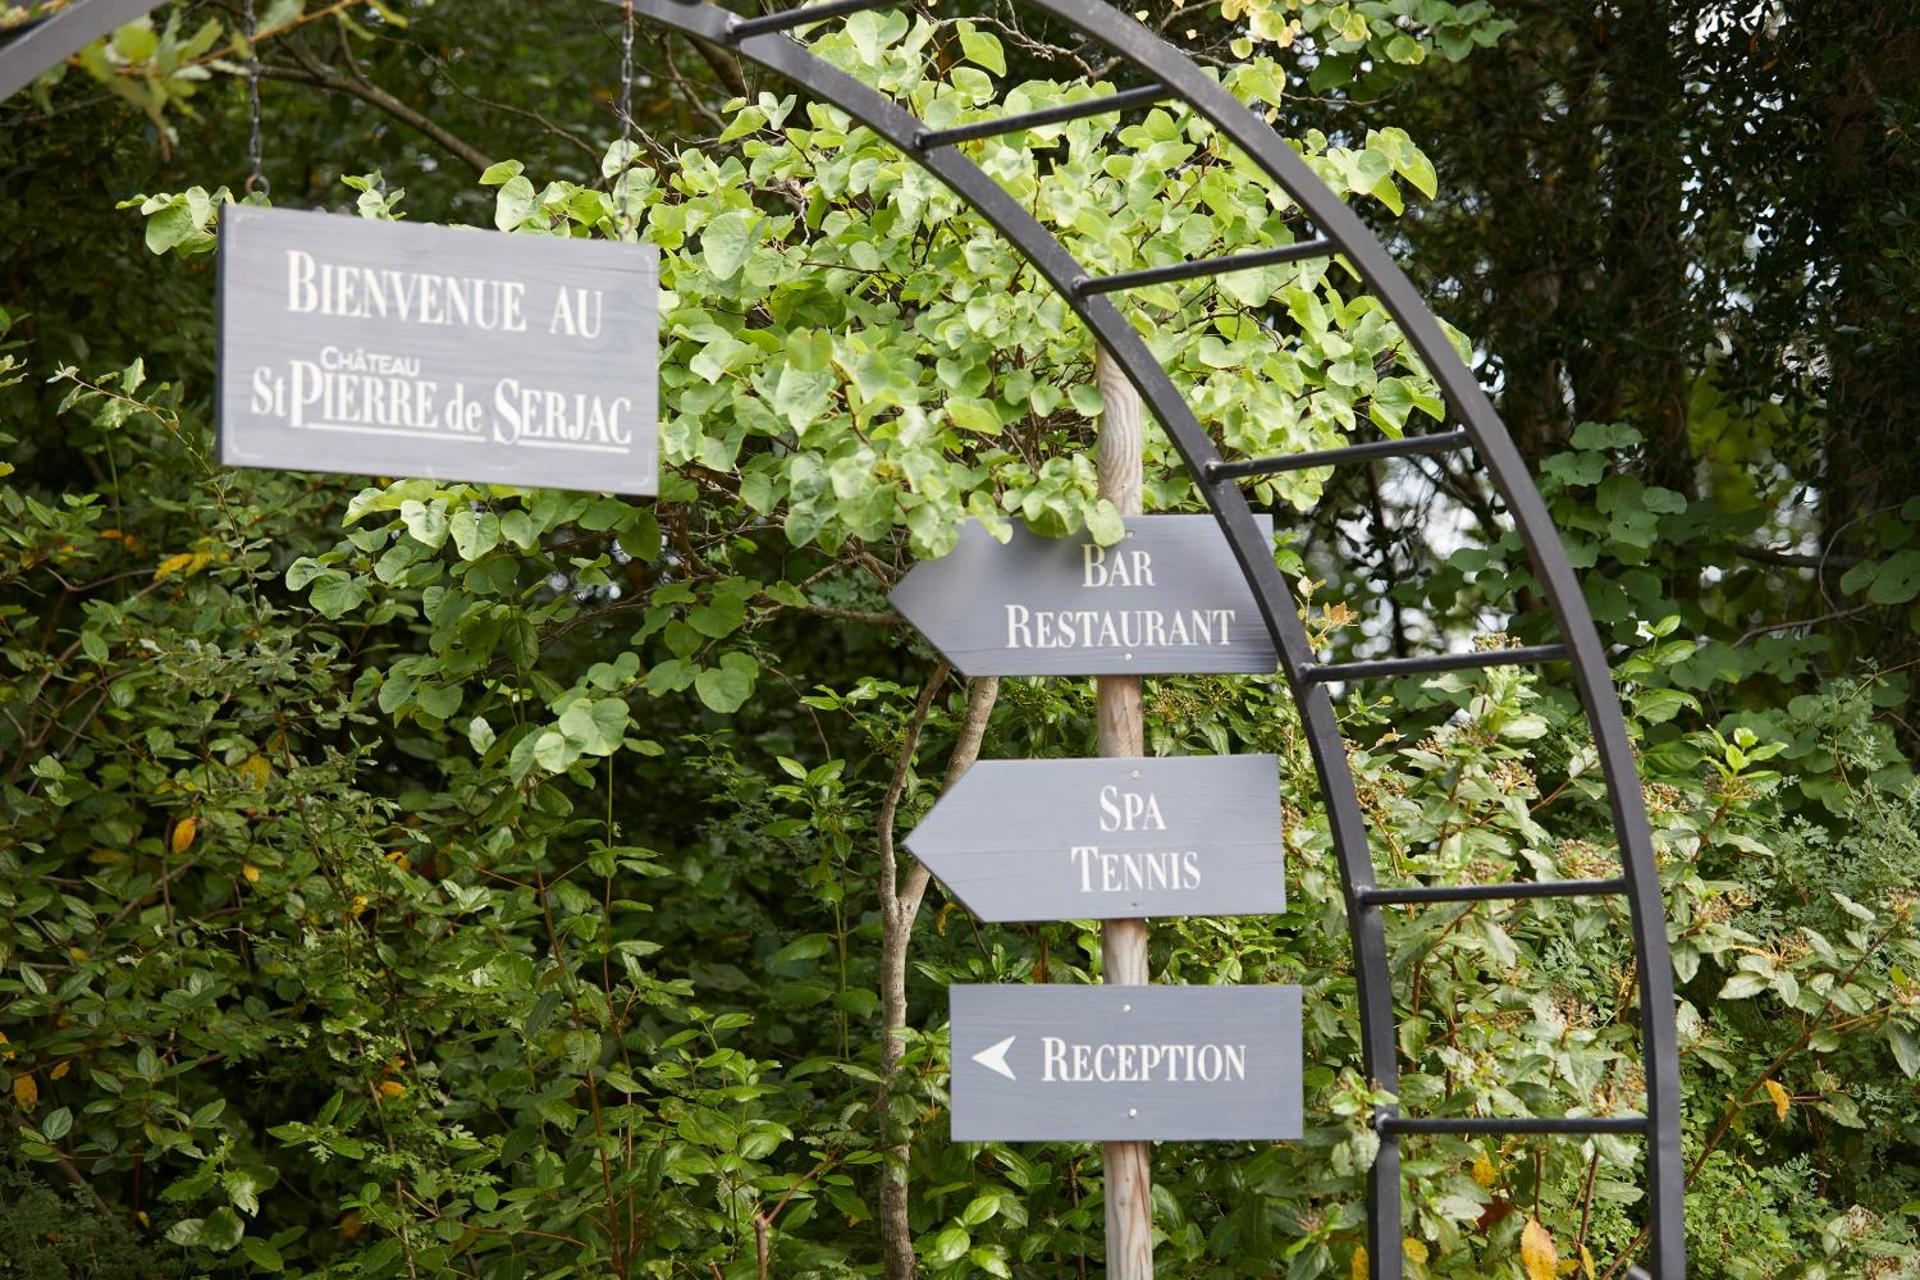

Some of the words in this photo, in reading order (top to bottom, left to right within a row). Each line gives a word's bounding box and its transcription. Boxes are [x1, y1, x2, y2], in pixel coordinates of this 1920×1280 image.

[286, 250, 527, 332] BIENVENUE
[549, 286, 603, 338] AU
[319, 345, 421, 378] CHÂTEAU
[444, 382, 482, 435] de
[492, 377, 633, 446] SERJAC
[1081, 543, 1156, 587] BAR
[1005, 604, 1236, 648] RESTAURANT
[1099, 785, 1167, 832] SPA
[1071, 846, 1201, 893] TENNIS
[1041, 1037, 1247, 1082] RECEPTION
